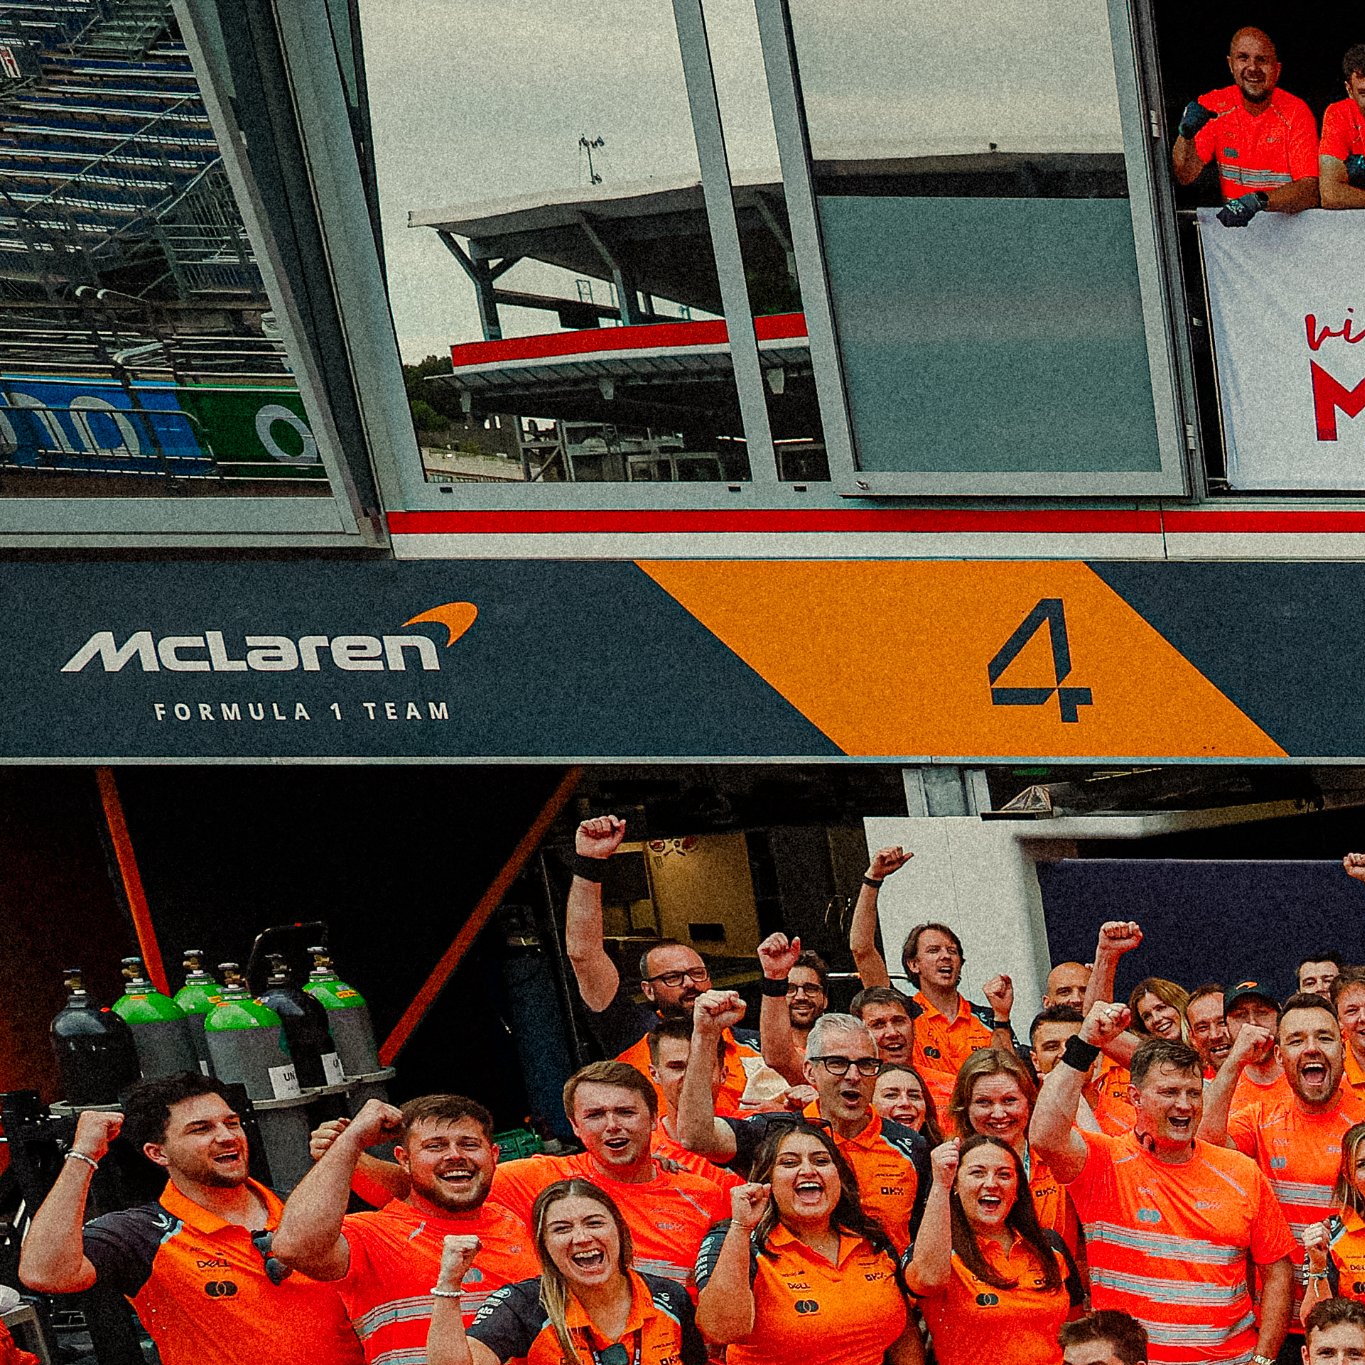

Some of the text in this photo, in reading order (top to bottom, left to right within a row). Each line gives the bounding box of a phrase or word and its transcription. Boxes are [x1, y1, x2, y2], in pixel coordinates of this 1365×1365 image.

[60, 631, 441, 672] McLaren
[988, 598, 1093, 723] 4
[154, 702, 450, 721] FORMULA 1 TEAM
[196, 1259, 230, 1269] DELL
[788, 1281, 810, 1290] DELL
